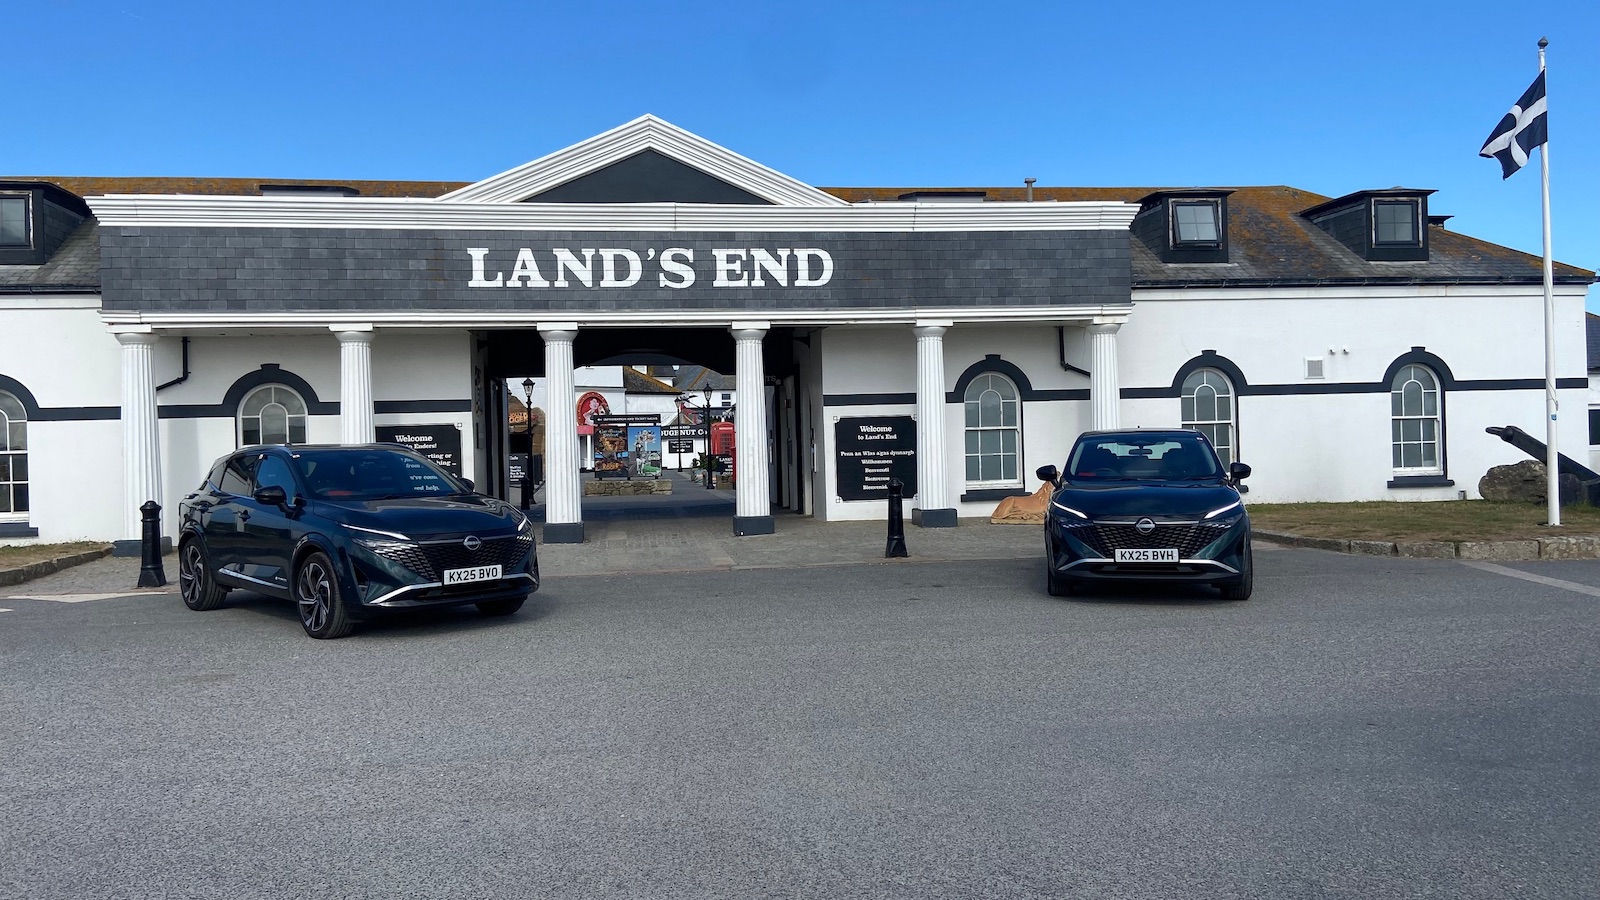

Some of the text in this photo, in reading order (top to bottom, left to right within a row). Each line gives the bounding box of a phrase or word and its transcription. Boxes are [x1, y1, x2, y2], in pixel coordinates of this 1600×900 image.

[466, 247, 834, 289] LAND'S END
[859, 425, 893, 433] Welcome
[395, 434, 433, 442] Welcome
[1120, 550, 1174, 561] KX25 BVH
[449, 567, 498, 583] KX25 BVO
